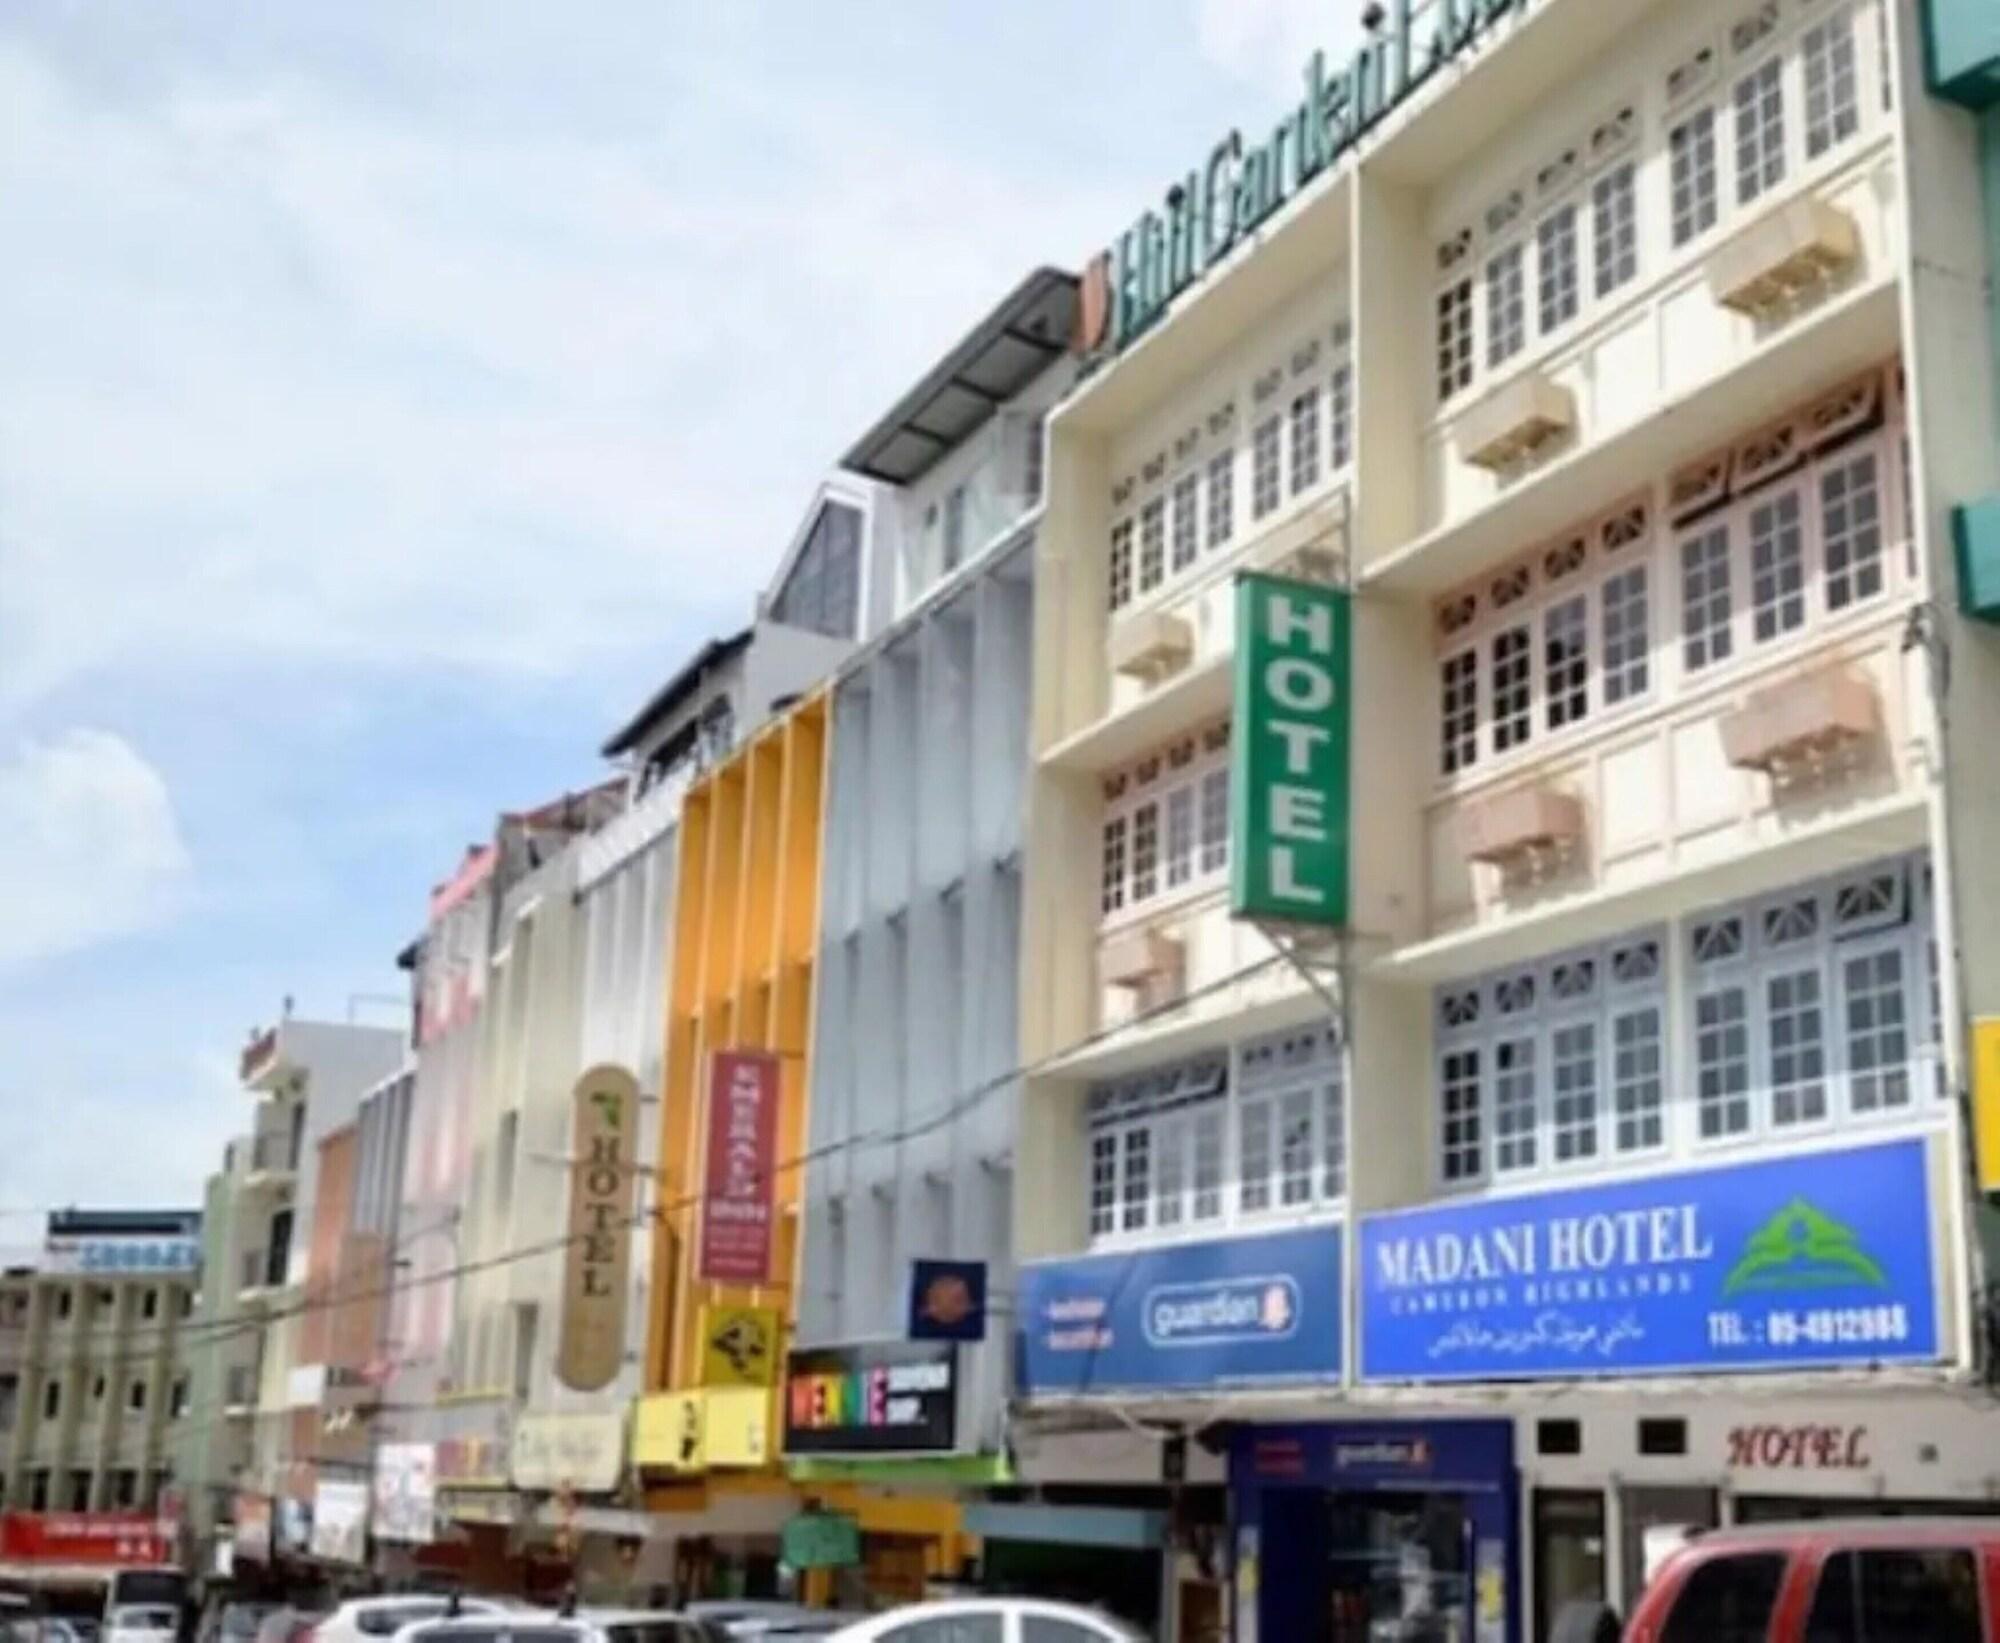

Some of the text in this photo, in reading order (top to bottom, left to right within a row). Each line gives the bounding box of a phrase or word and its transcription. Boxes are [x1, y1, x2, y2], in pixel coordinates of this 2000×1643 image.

[1265, 593, 1332, 904] HOTEL
[582, 1135, 620, 1298] HOTEL
[1378, 1203, 1713, 1287] MADANI HOTEL
[1153, 1287, 1259, 1338] guardian
[1390, 1271, 1693, 1315] CAMERON HIGHLANDS
[1726, 1422, 1871, 1470] HOTEL
